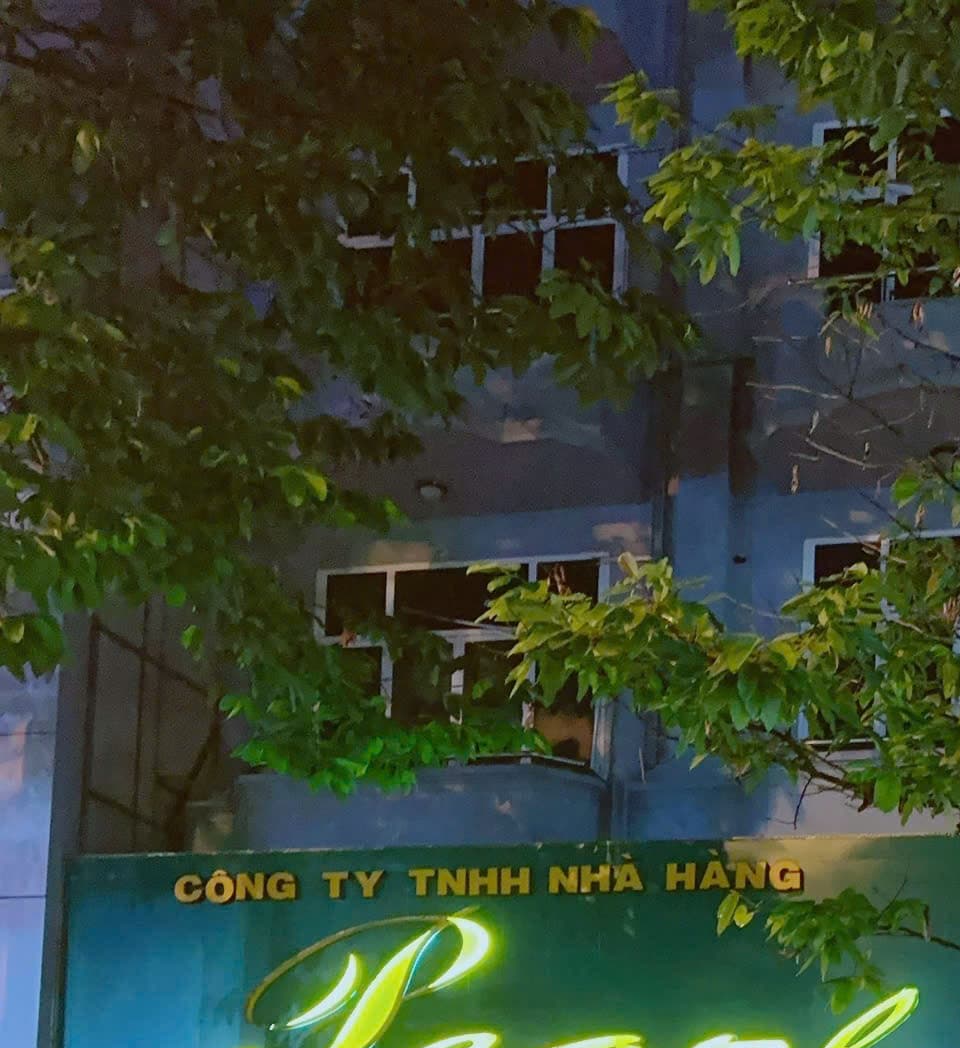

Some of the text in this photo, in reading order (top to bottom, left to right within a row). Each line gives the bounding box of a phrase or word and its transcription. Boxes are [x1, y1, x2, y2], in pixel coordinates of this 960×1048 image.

[174, 849, 804, 904] CÔNG TY TNHH NHÀ HÀNG
